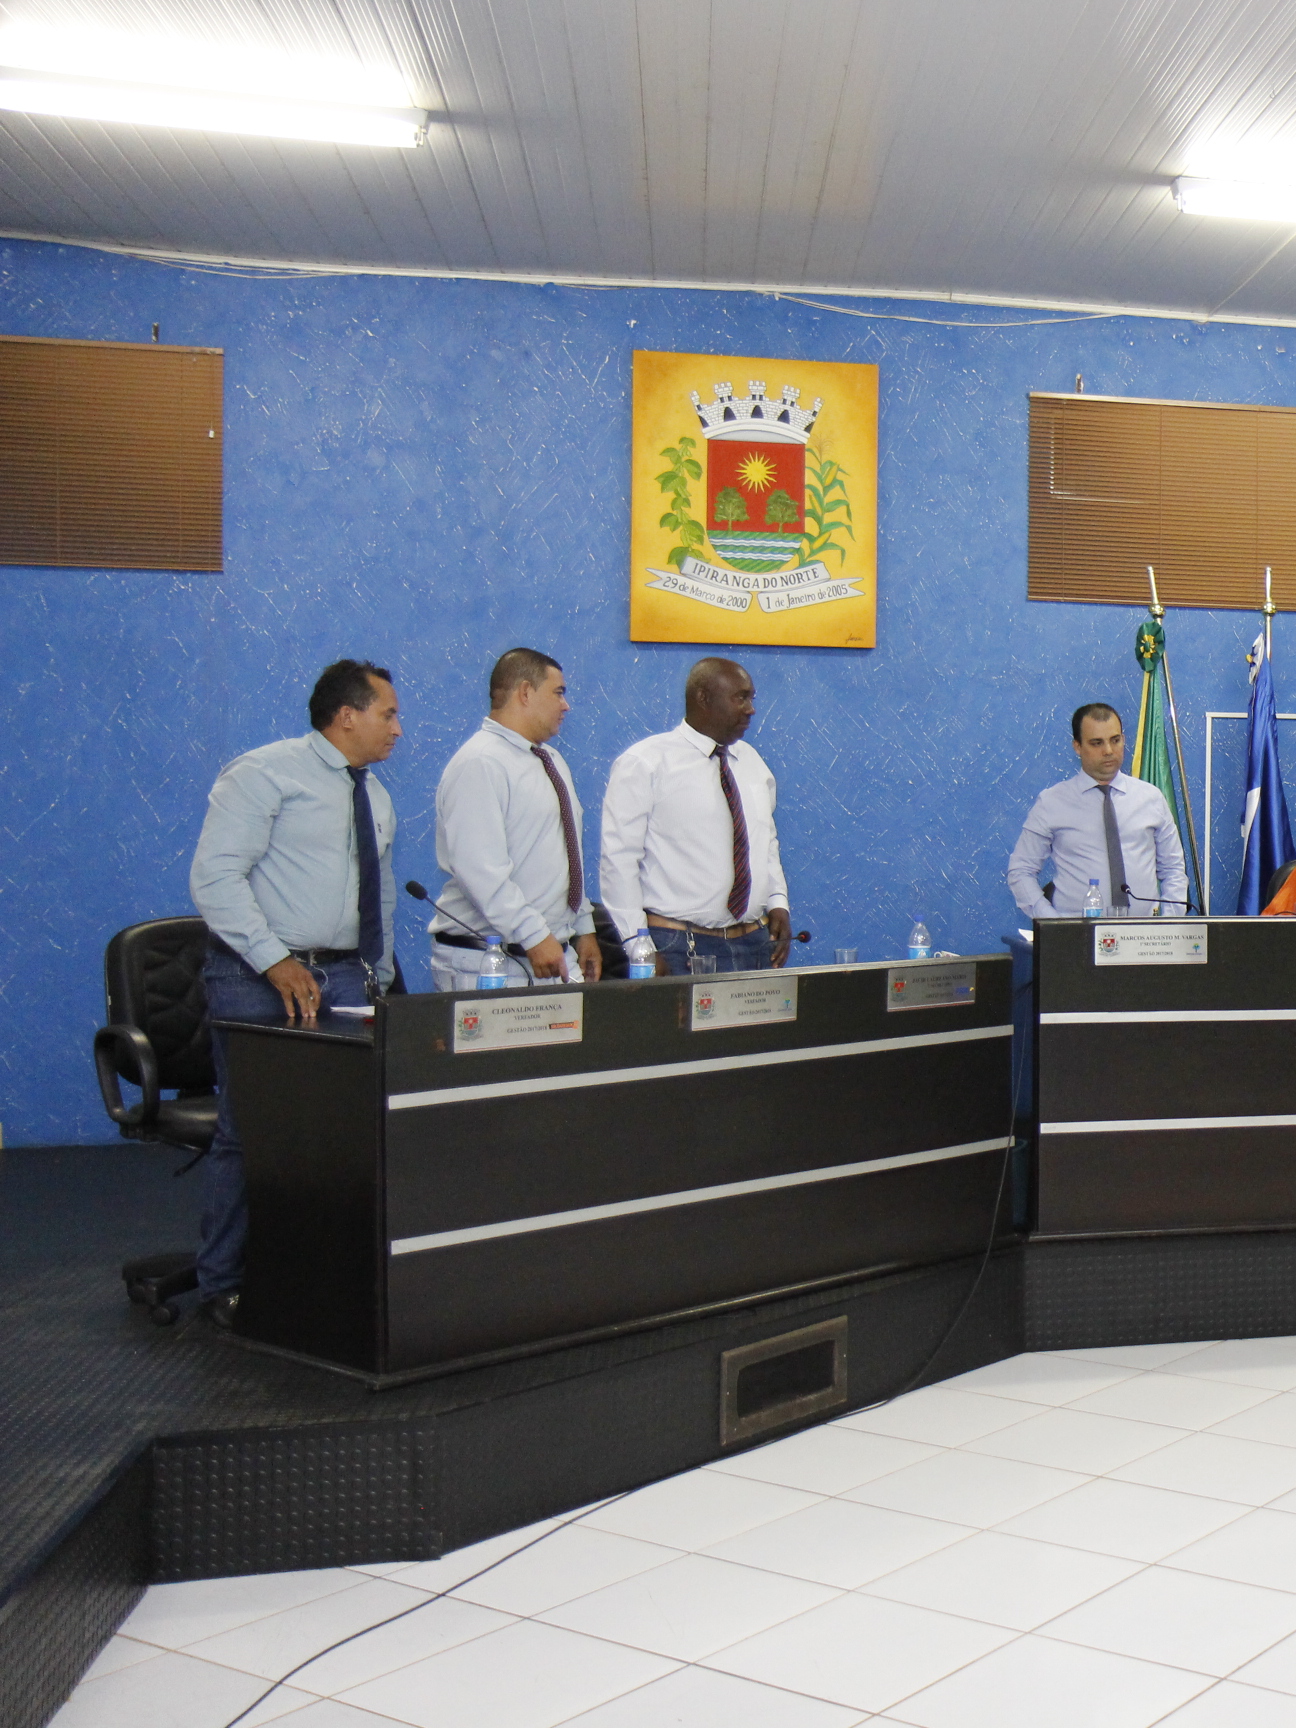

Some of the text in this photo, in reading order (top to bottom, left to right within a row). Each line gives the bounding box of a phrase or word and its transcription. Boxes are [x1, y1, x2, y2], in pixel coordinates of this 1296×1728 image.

[693, 562, 819, 589] IPIRANGA DO NORTE
[663, 576, 748, 609] 29 de Março de 2000
[766, 583, 848, 609] 1 de Janeiro de 2005
[492, 1004, 562, 1015] CLEONALDO FRANÇA
